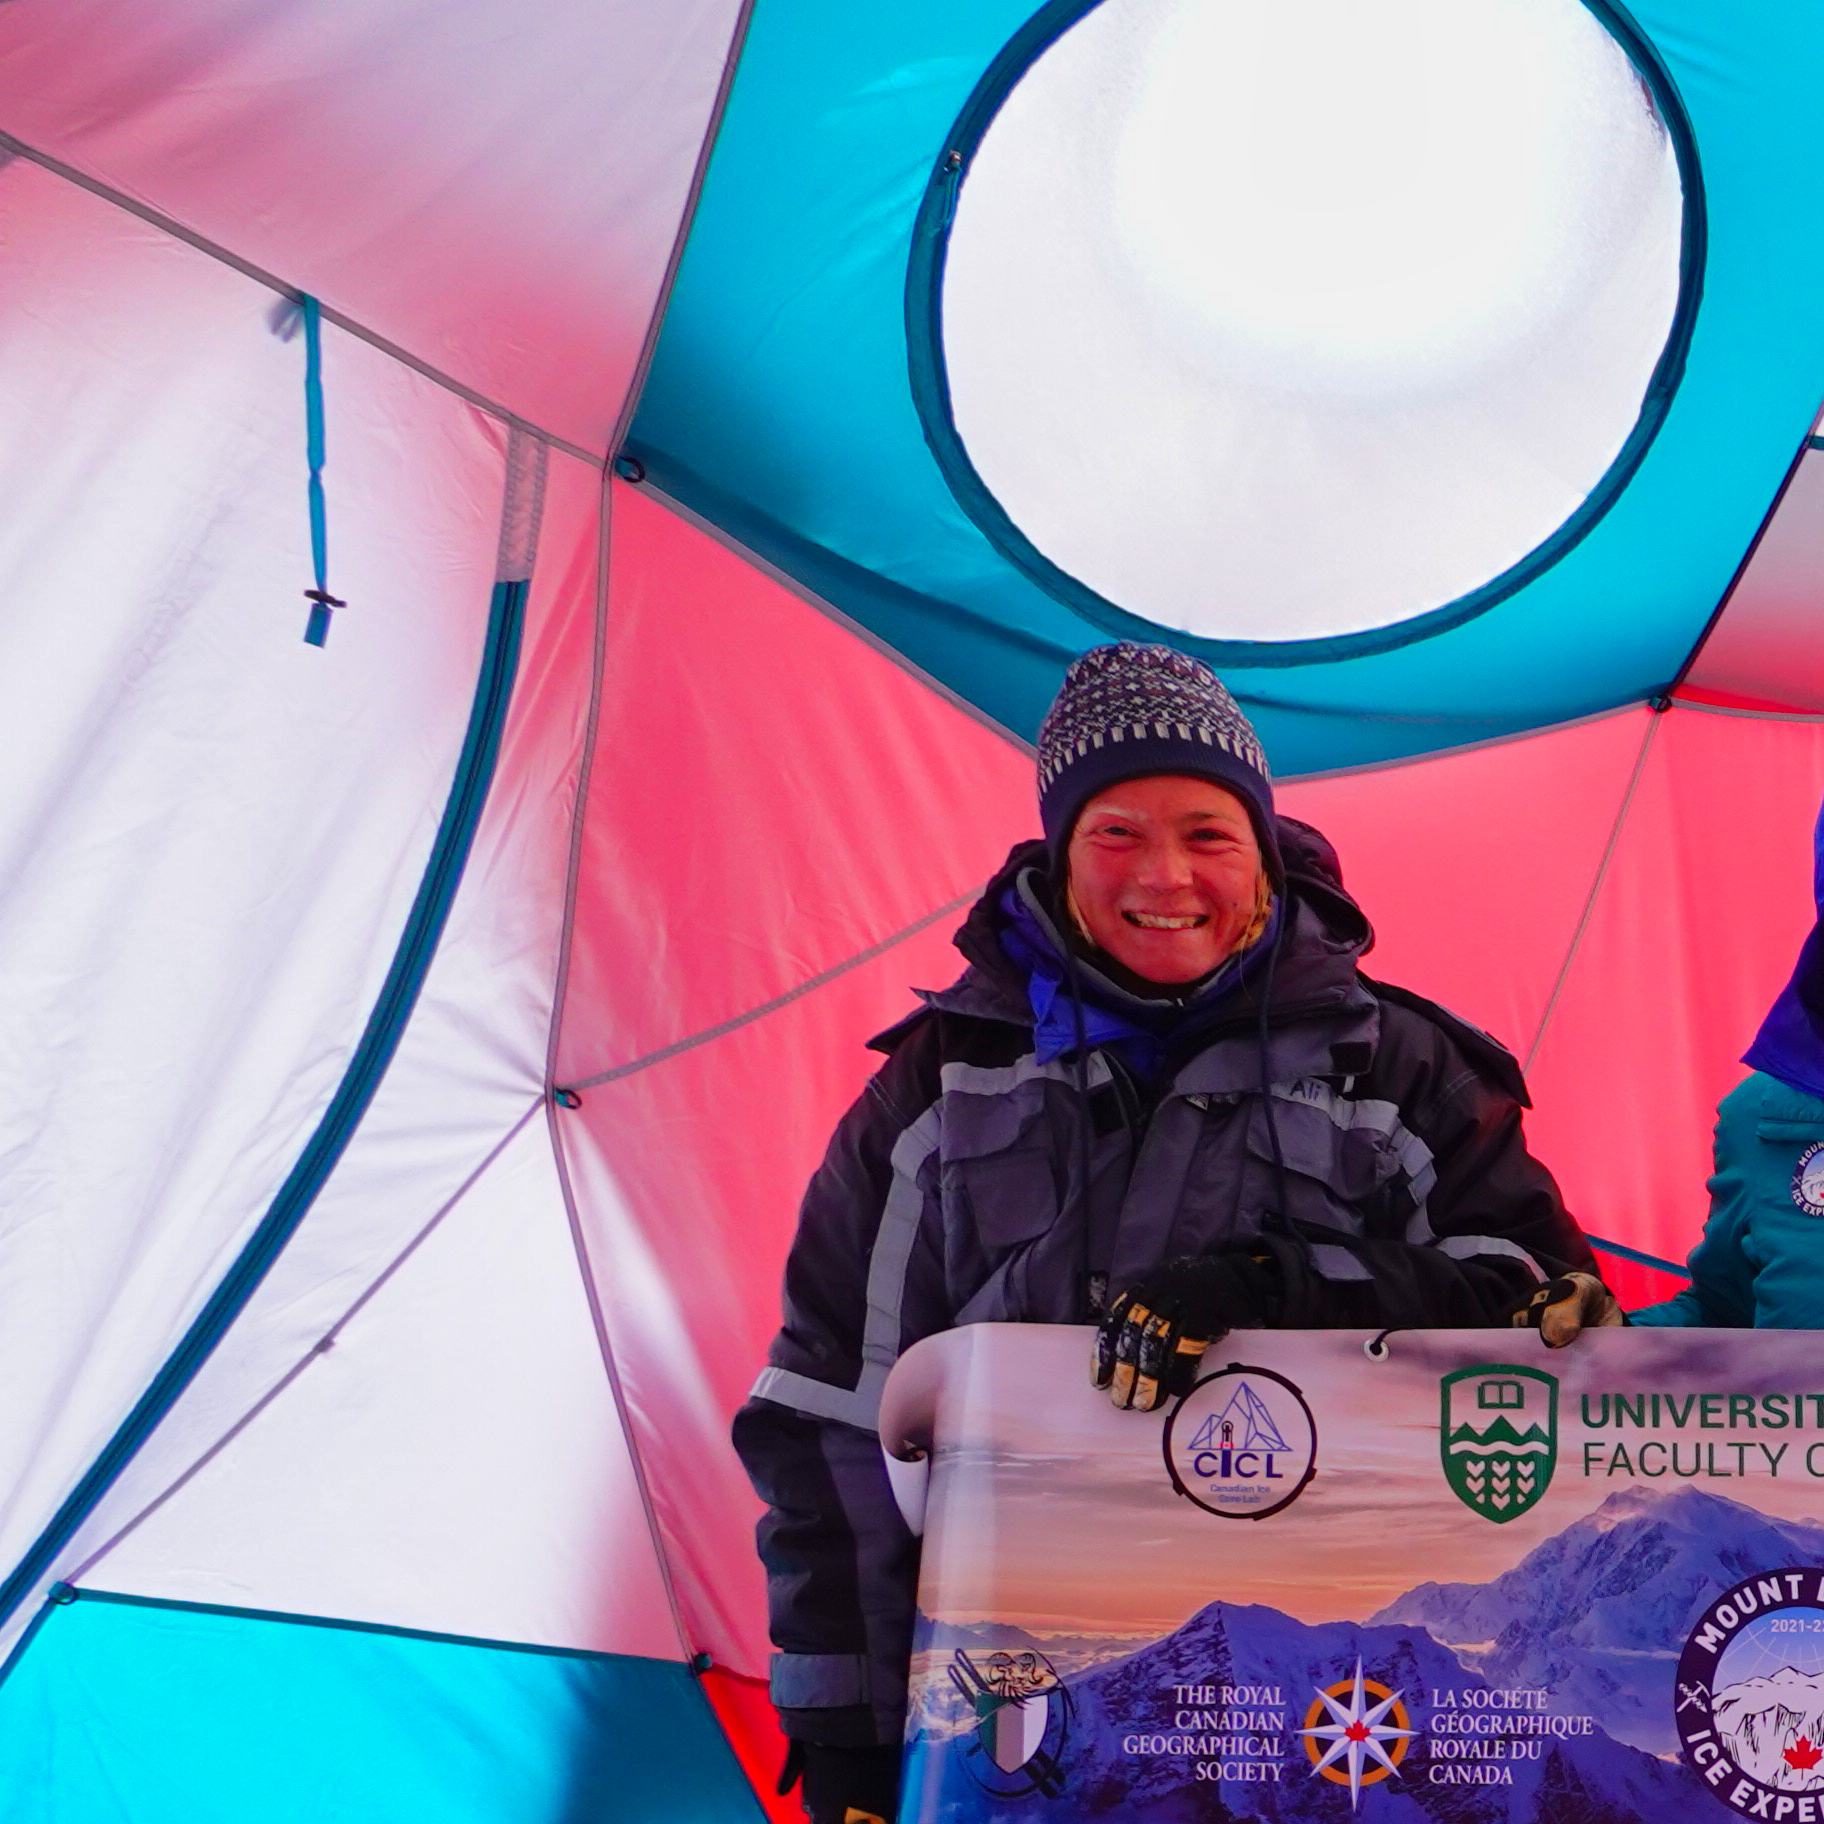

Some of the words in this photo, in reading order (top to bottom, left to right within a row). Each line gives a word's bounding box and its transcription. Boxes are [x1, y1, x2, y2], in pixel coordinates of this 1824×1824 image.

[1792, 1189, 1804, 1206] ICE
[1193, 1449, 1284, 1479] CICL
[1583, 1442, 1790, 1478] FACULTY
[1210, 1483, 1255, 1493] Canadian
[1257, 1483, 1271, 1493] Ice
[1694, 1573, 1804, 1655] MOUNT
[1172, 1684, 1217, 1705] THE
[1220, 1685, 1287, 1706] ROYAL
[1432, 1688, 1458, 1708] LA
[1462, 1686, 1549, 1709] SOCIÉTÉ
[1174, 1709, 1285, 1731] CANADIAN
[1430, 1710, 1594, 1740] GÉOGRAPHIQUE
[1123, 1734, 1285, 1757] GEOGRAPHICAL
[1429, 1739, 1506, 1759] ROYALE
[1510, 1740, 1544, 1760] DU
[1686, 1728, 1733, 1786] ICE
[1195, 1761, 1285, 1782] SOCIETY
[1428, 1764, 1514, 1785] CANADA
